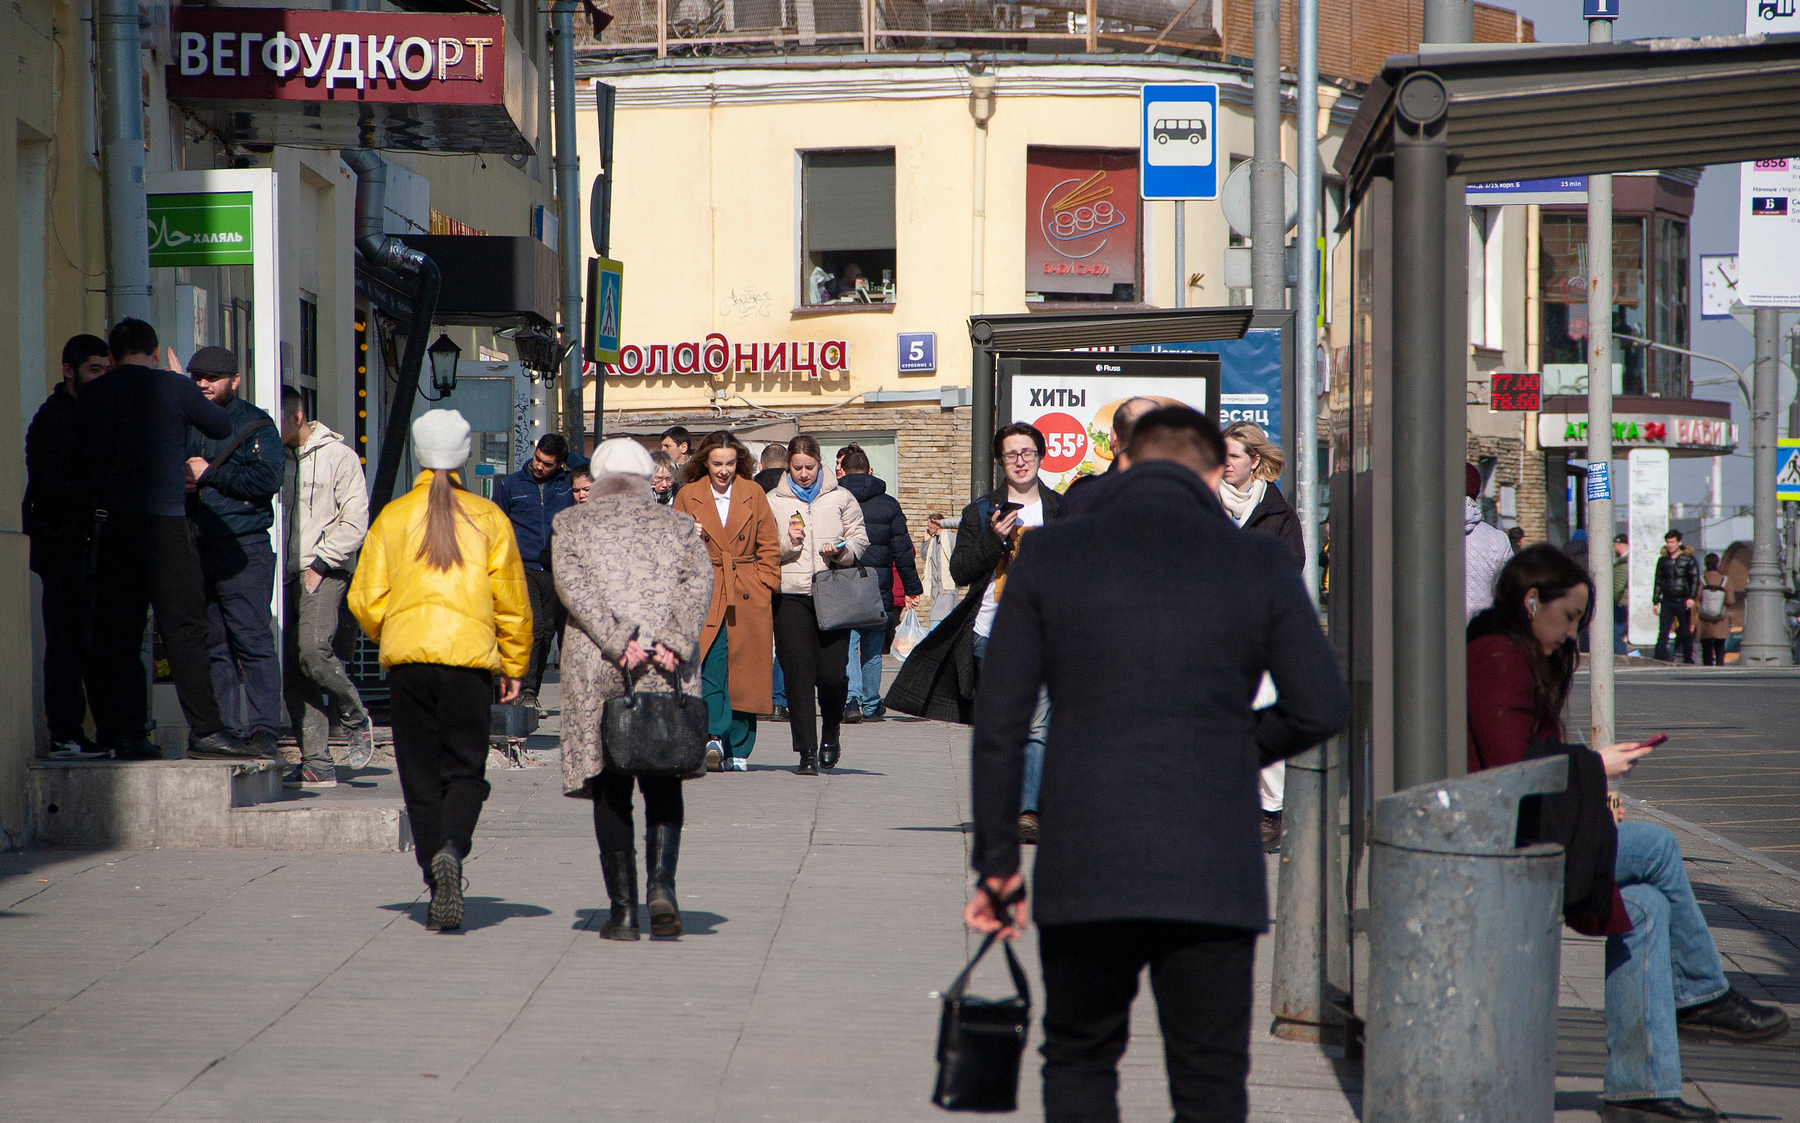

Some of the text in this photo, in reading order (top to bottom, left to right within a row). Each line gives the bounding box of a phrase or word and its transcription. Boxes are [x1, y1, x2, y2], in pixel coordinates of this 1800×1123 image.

[179, 31, 494, 90] ВЕГФУДКОРТ
[193, 232, 243, 244] ХАЛЯЛЬ
[909, 340, 924, 361] 5
[1491, 374, 1539, 391] 77.00
[1029, 388, 1087, 408] ХИТЫ
[1220, 409, 1270, 426] есяц
[1564, 421, 1667, 440] АПКА 24
[1043, 432, 1085, 458] 55₽
